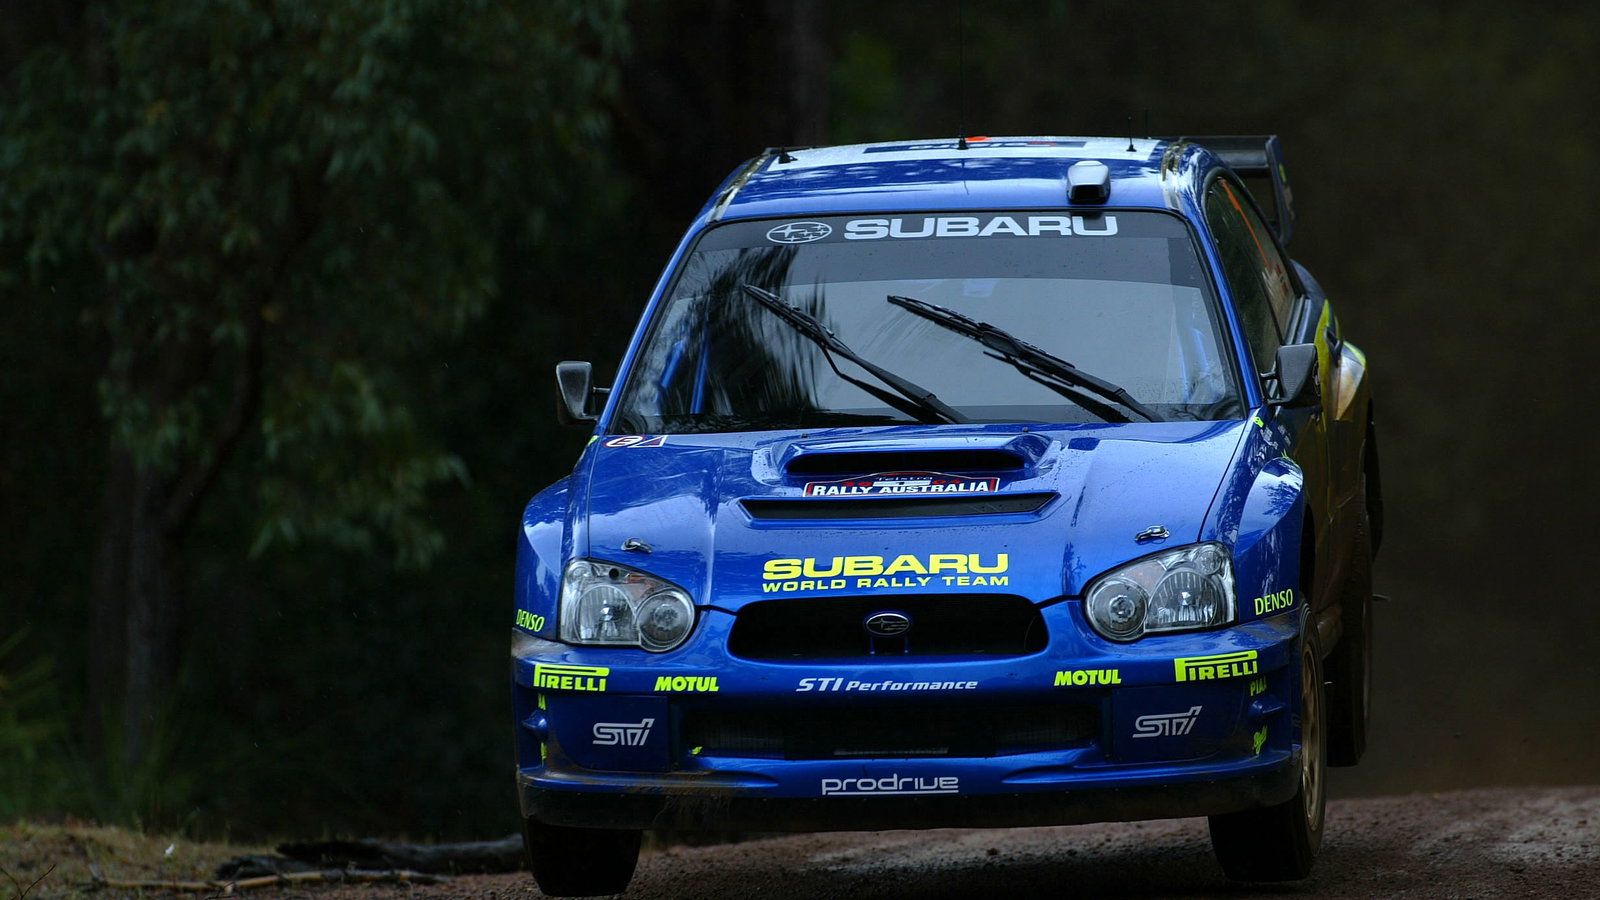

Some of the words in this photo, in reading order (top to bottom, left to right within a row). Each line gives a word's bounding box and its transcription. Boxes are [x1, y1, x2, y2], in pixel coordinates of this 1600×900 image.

[844, 216, 1119, 240] SUBARU
[813, 485, 873, 495] RALLY
[879, 481, 989, 494] AUSTRALIA
[762, 553, 1009, 580] SUBARU
[762, 579, 847, 593] WORLD
[857, 576, 931, 588] RALLY
[942, 576, 1009, 587] TEAM
[1254, 589, 1294, 616] DENSO
[515, 609, 545, 632] DENSO
[1054, 669, 1122, 686] MOTUL
[1173, 650, 1258, 682] PIRELLI
[533, 664, 610, 692] PIRELLI
[654, 676, 720, 692] MOTUL
[795, 677, 844, 692] STI
[845, 680, 979, 692] Performance
[821, 773, 960, 796] prodrive
